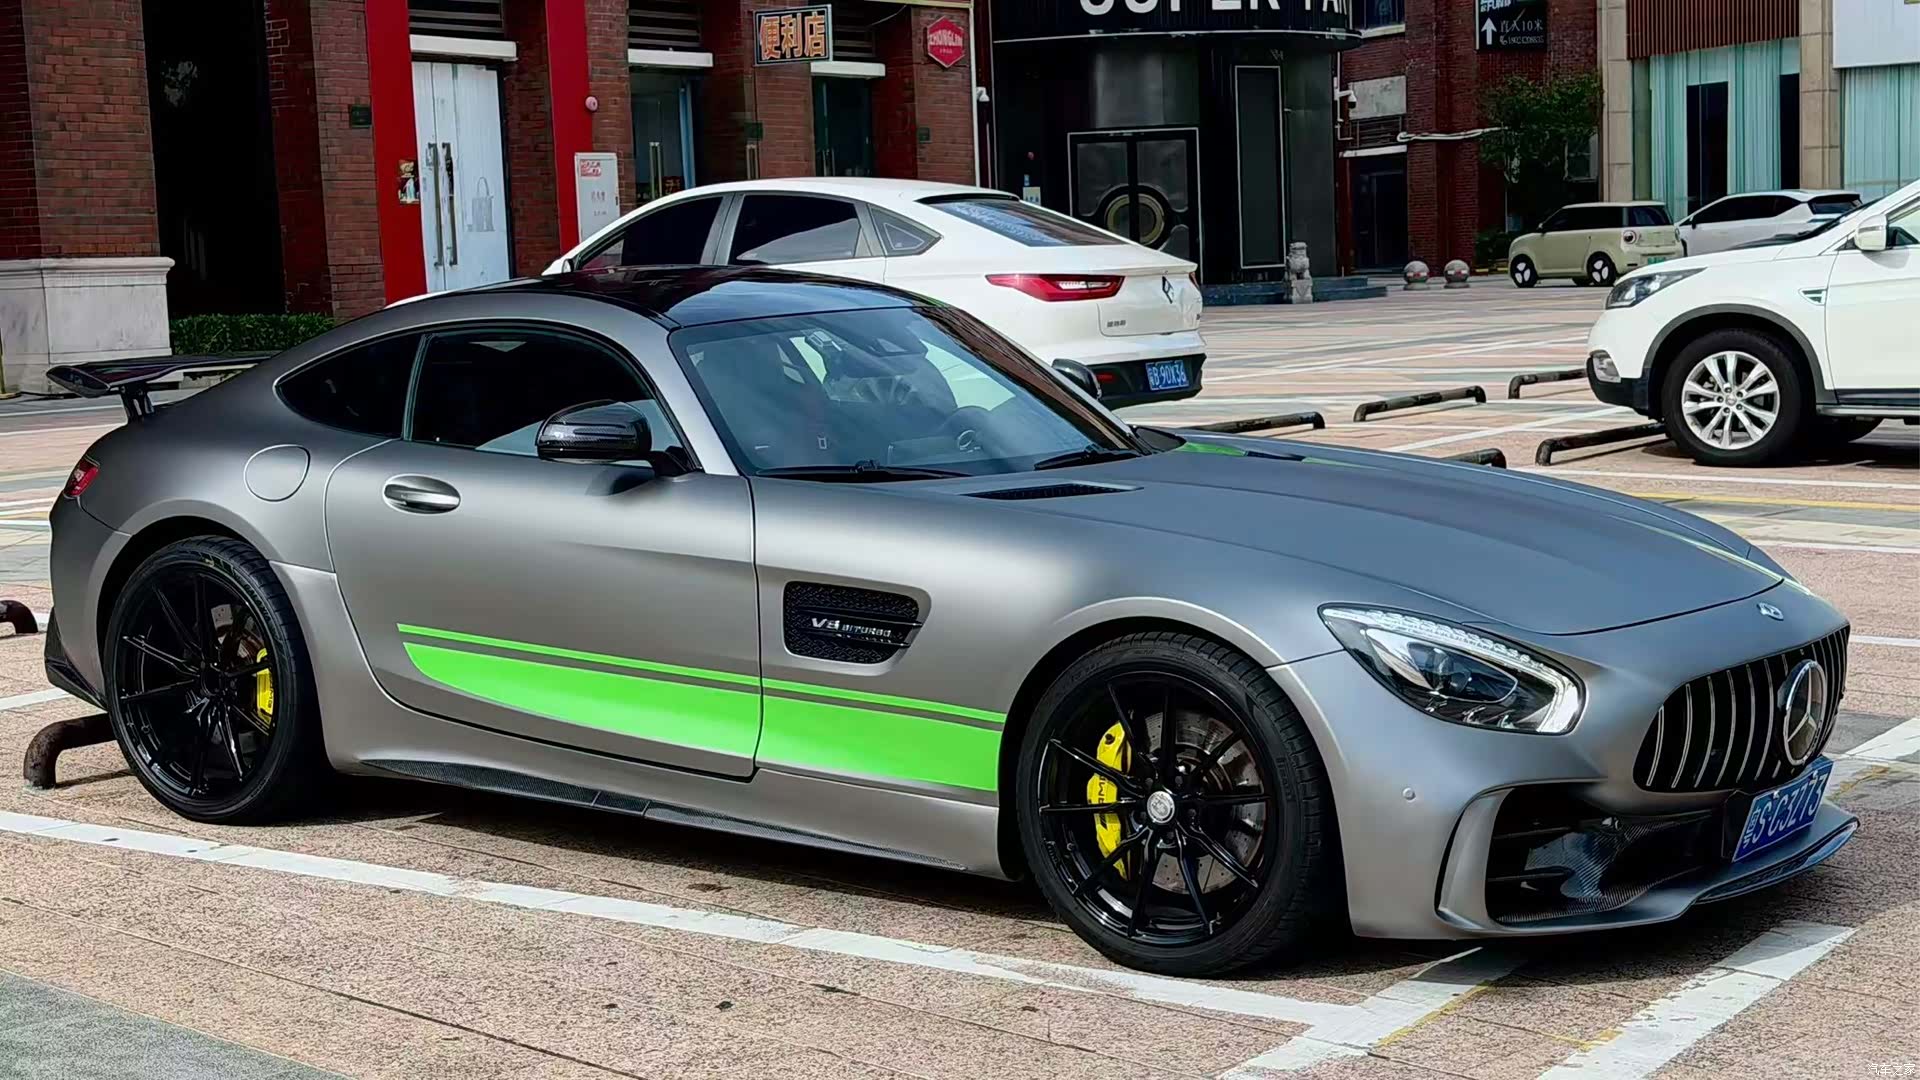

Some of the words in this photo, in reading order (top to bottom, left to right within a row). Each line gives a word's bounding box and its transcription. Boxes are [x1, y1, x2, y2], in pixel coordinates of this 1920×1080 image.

[760, 12, 825, 60] 便利店
[812, 617, 841, 630] V8
[842, 624, 892, 637] BITURBO
